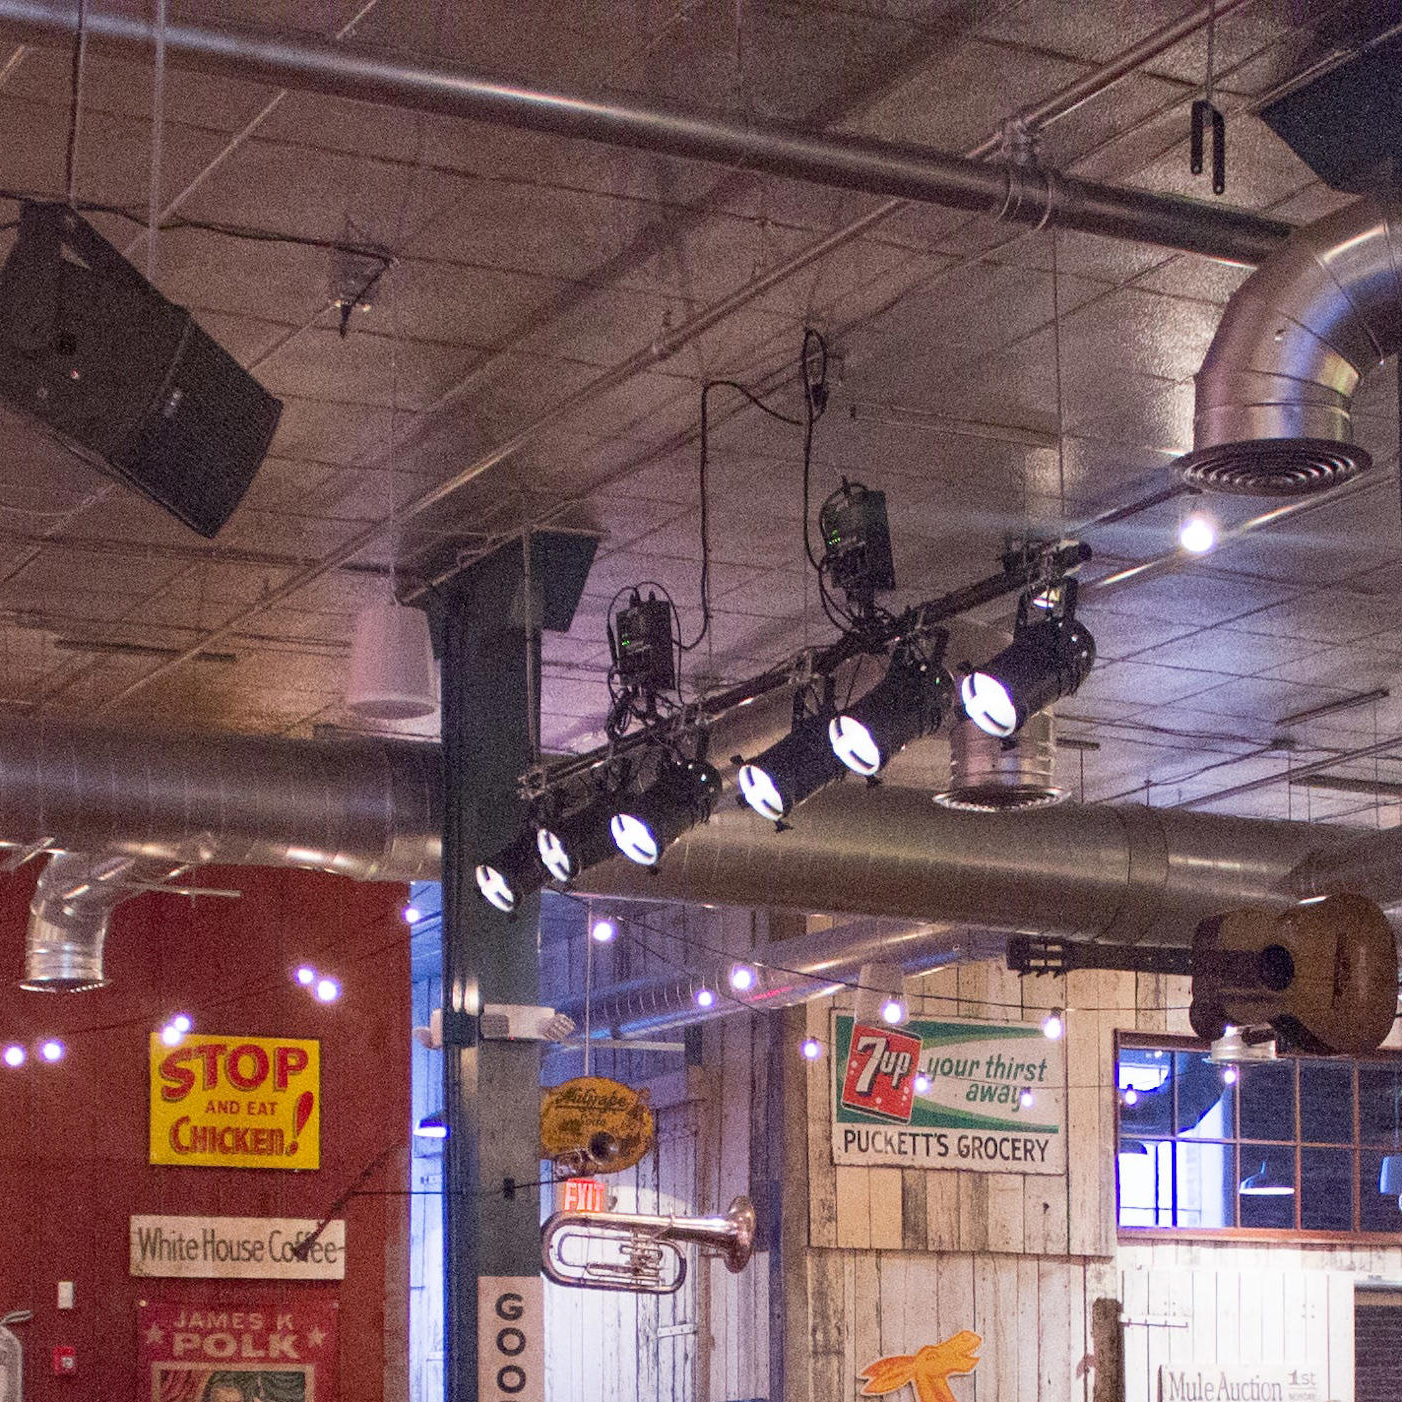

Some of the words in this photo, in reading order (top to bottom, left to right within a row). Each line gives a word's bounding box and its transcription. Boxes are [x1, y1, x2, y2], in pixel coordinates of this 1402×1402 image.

[160, 1043, 309, 1102] STOP
[927, 1055, 980, 1082] your
[984, 1053, 1048, 1082] thirst
[205, 1100, 240, 1115] AND
[247, 1101, 278, 1116] EAT
[965, 1084, 1030, 1113] away
[844, 1129, 948, 1157] PUCKETT'S
[957, 1135, 1049, 1163] GROCERY
[563, 1182, 604, 1212] EXIT
[138, 1227, 198, 1262] White
[202, 1228, 264, 1264] House
[174, 1312, 264, 1331] JAMES
[276, 1313, 295, 1330] K
[172, 1332, 301, 1359] POLK
[1168, 1372, 1214, 1401] Mule
[1216, 1371, 1284, 1401] Auction
[1288, 1369, 1317, 1386] 1st
